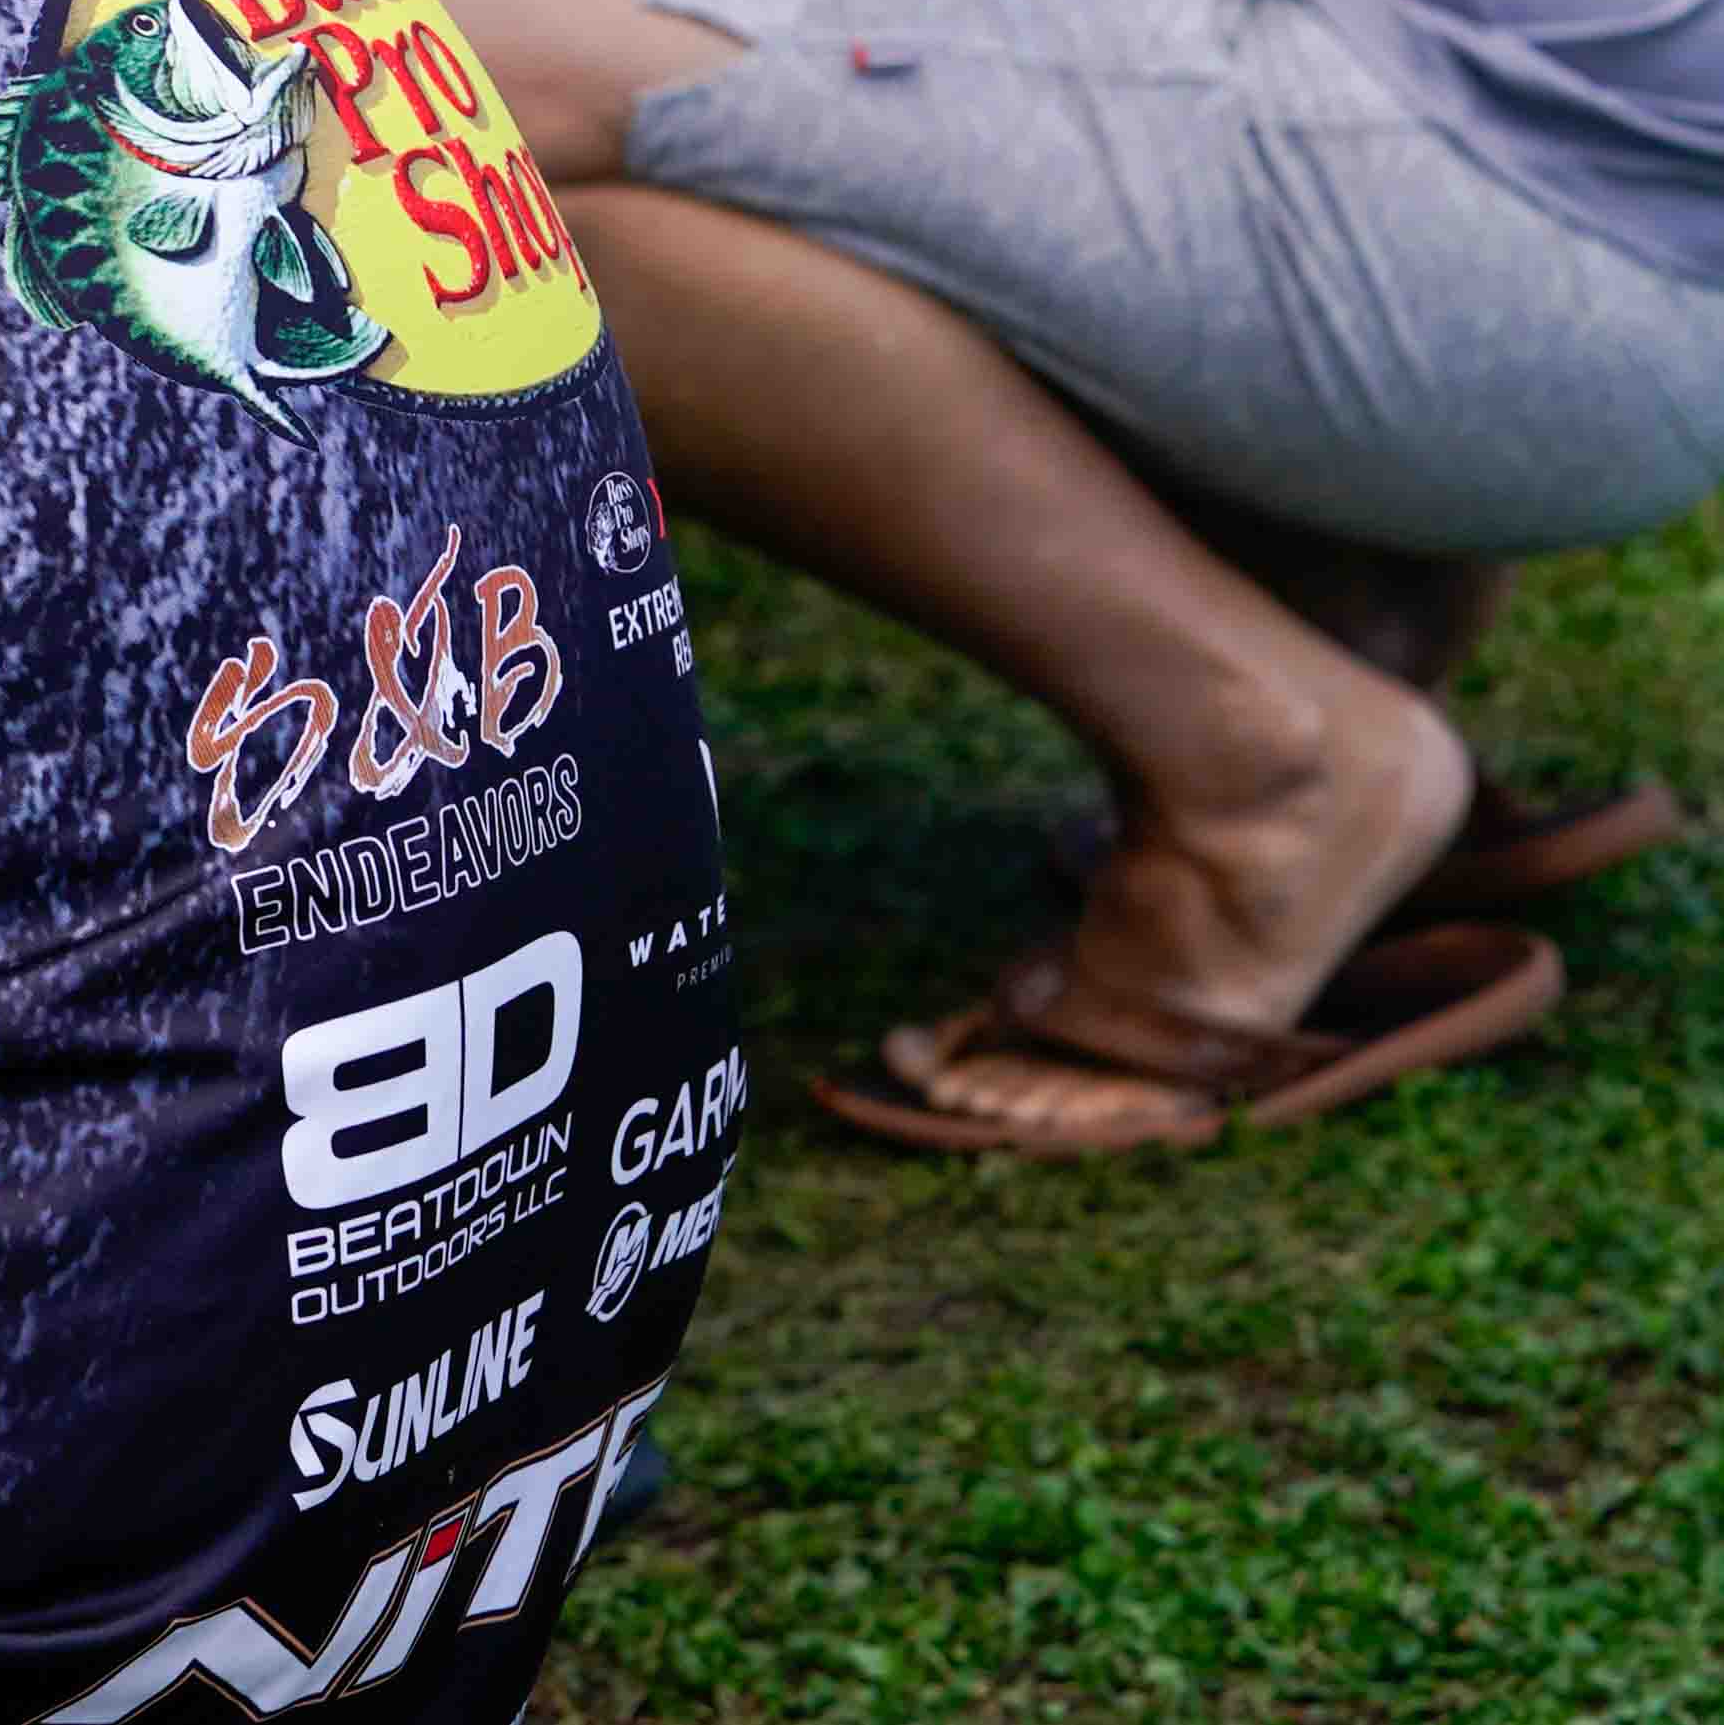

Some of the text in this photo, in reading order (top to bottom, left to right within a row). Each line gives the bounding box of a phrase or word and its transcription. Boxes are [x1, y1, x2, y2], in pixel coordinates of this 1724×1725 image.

[287, 19, 478, 166] Pro
[231, 752, 583, 955] ENDEAVORS
[281, 931, 584, 1211] BD
[287, 1112, 572, 1278] BEATDOWN
[291, 1172, 566, 1325] OUTDOORS LLC
[289, 1289, 546, 1512] SUNLINE
